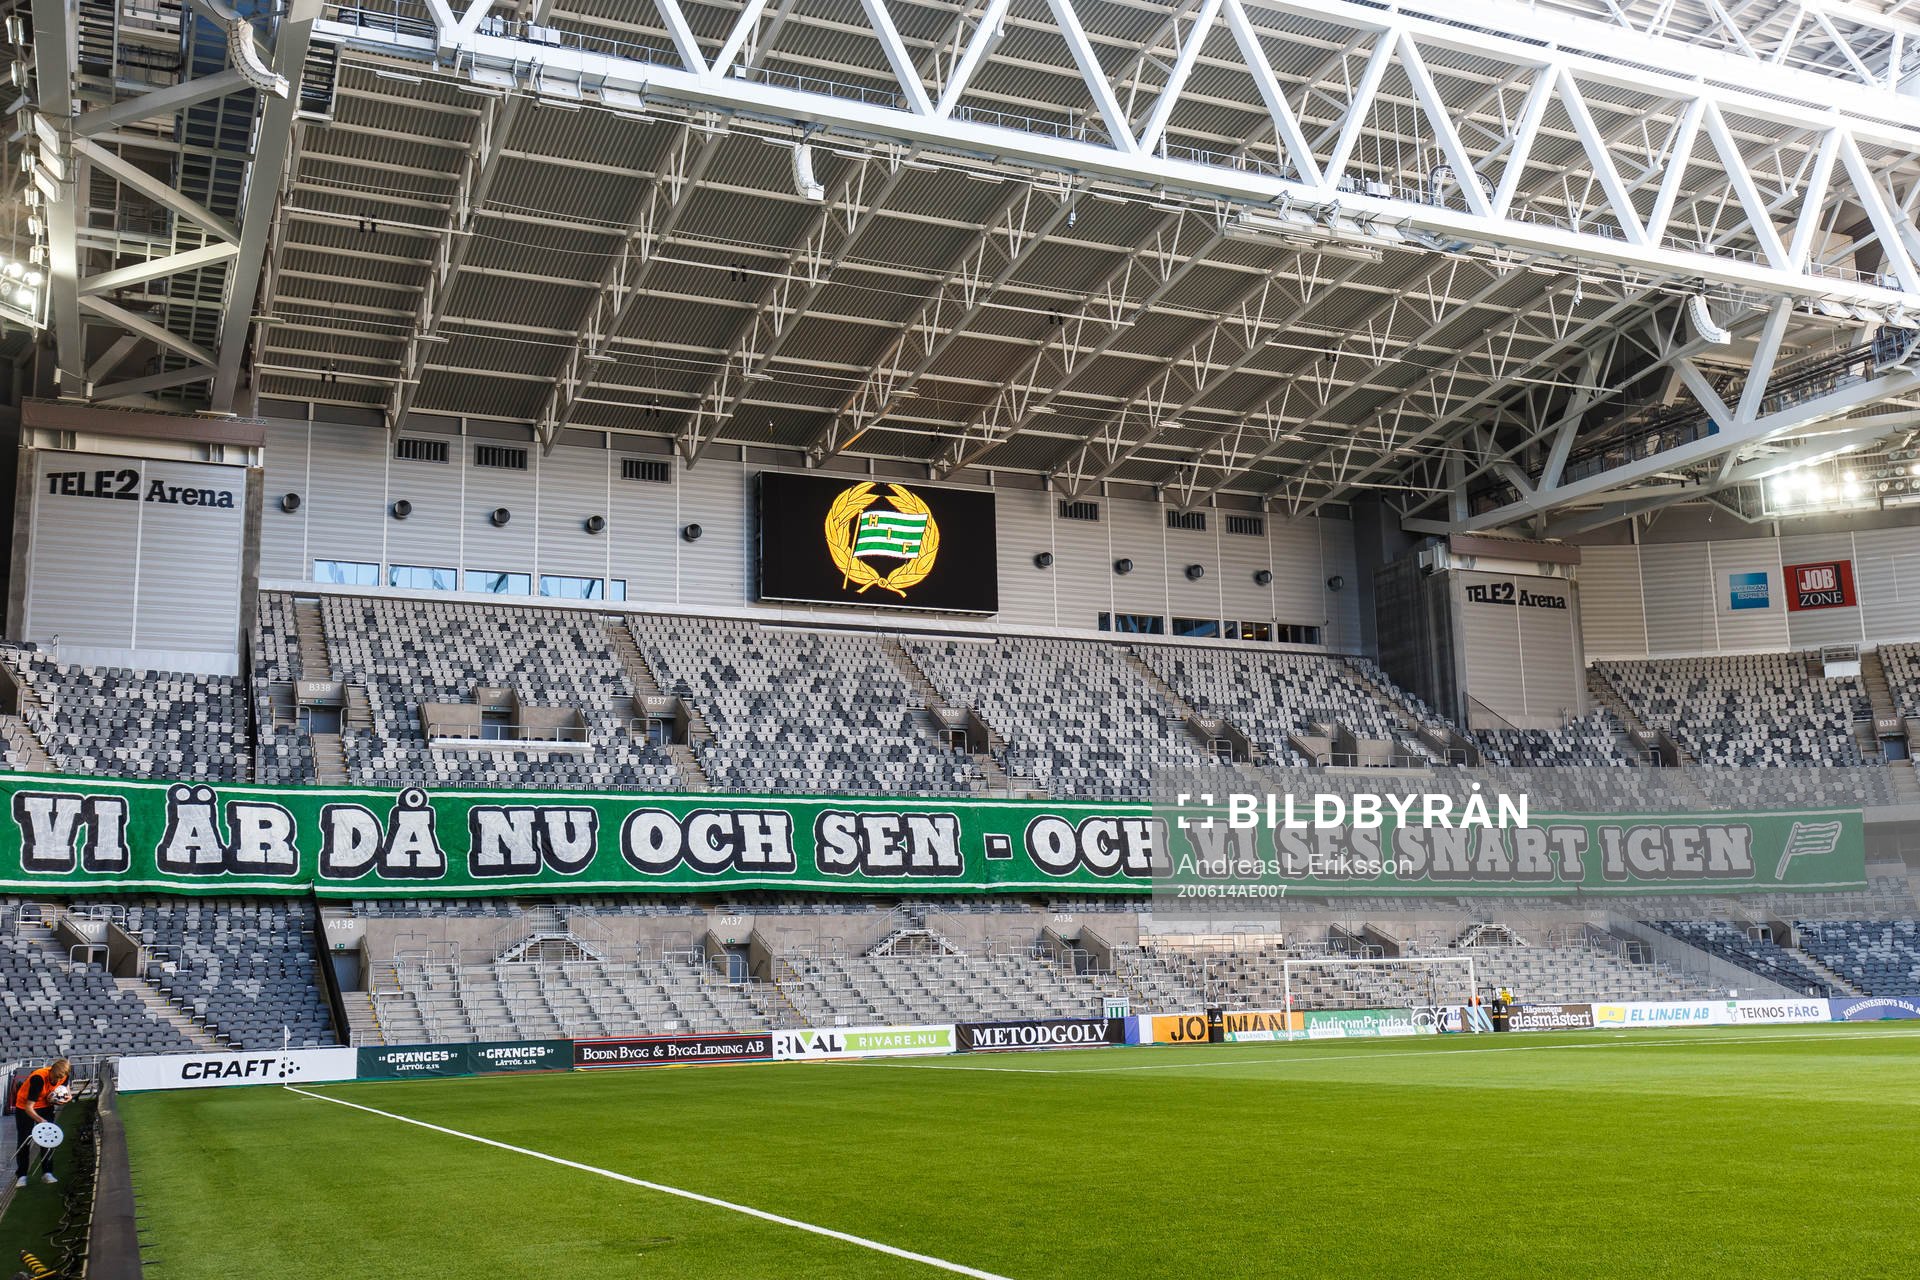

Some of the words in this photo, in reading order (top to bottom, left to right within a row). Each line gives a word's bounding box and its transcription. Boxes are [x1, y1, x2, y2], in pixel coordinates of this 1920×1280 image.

[46, 469, 140, 500] TELE2
[145, 479, 234, 508] Arena
[1800, 568, 1835, 591] JOB
[1465, 583, 1516, 605] TELE2
[1518, 589, 1567, 609] Arena
[1800, 591, 1843, 606] ZONE
[15, 792, 128, 871] VI
[157, 784, 298, 875] ÄR
[320, 787, 446, 878] DÅ
[468, 805, 599, 876] NU
[621, 808, 796, 874] OCH
[814, 810, 964, 877] SEN
[985, 833, 1012, 859] -
[1026, 815, 1173, 878] OCH
[1393, 822, 1588, 882] SNART
[1599, 824, 1756, 881] IGEN
[328, 920, 354, 929] A138
[721, 917, 742, 926] A137
[1631, 1008, 1643, 1021] EL
[1649, 1008, 1690, 1021] LINJEN
[1694, 1007, 1709, 1019] AB
[1740, 1006, 1785, 1019] TEKNOS
[1788, 1003, 1819, 1017] FÄRG
[1843, 998, 1897, 1019] JOHANNESHOVS
[1310, 1016, 1408, 1030] AudicomPendax
[1509, 1011, 1591, 1029] glasmästeri
[859, 1034, 937, 1047] RIVARE.NU
[972, 1022, 1109, 1046] METODGOLV
[387, 1051, 449, 1063] GRÄNGES
[487, 1047, 545, 1059] GRÄNGES
[653, 1046, 664, 1057] &
[746, 1041, 765, 1053] AB
[182, 1059, 276, 1080] CRAFT
